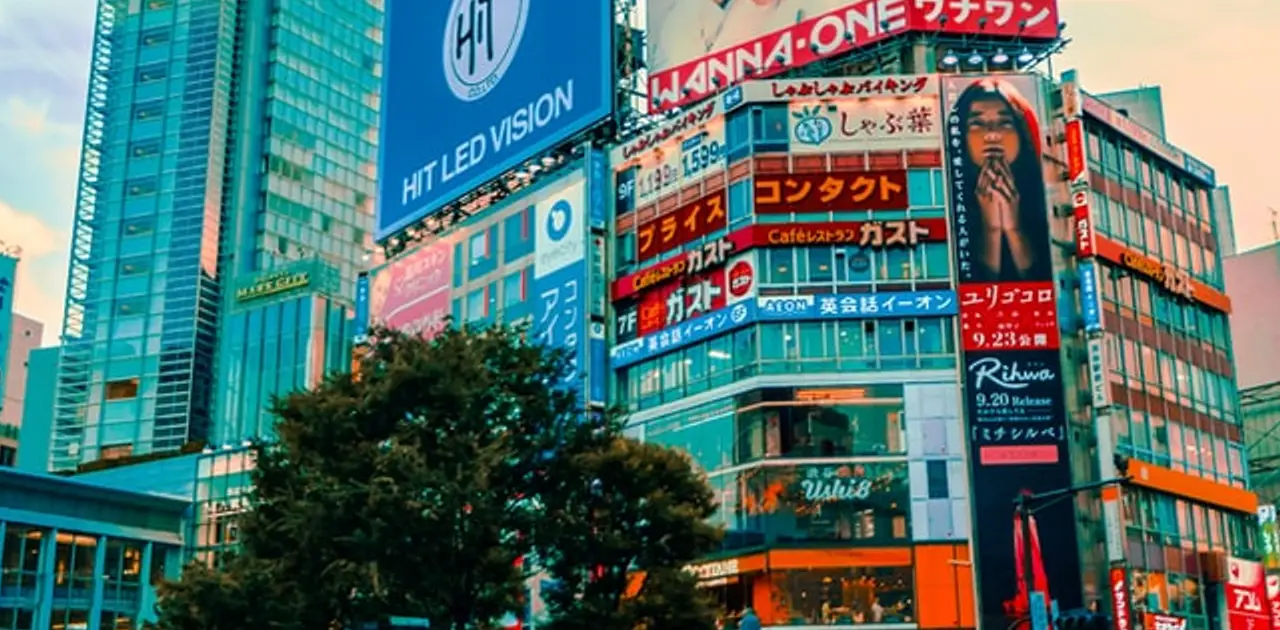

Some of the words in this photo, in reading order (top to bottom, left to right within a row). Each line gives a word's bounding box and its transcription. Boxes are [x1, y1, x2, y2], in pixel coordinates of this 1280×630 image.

[772, 76, 929, 98] しゃぶしゃぶバイキング
[840, 106, 934, 137] しゃぶ葉
[402, 160, 438, 206] HIT
[441, 133, 487, 183] LED
[489, 79, 574, 153] VISION
[755, 175, 902, 204] コンタクト
[639, 195, 724, 253] プライス
[859, 221, 930, 246] ガスト
[687, 238, 733, 273] ガスト
[666, 280, 722, 326] ガスト
[820, 296, 953, 315] 英会話イーオン
[962, 285, 1053, 310] ユリゴコロ
[618, 311, 637, 336] 7F
[968, 357, 1055, 390] Rihwa
[976, 391, 1010, 408] 9.20
